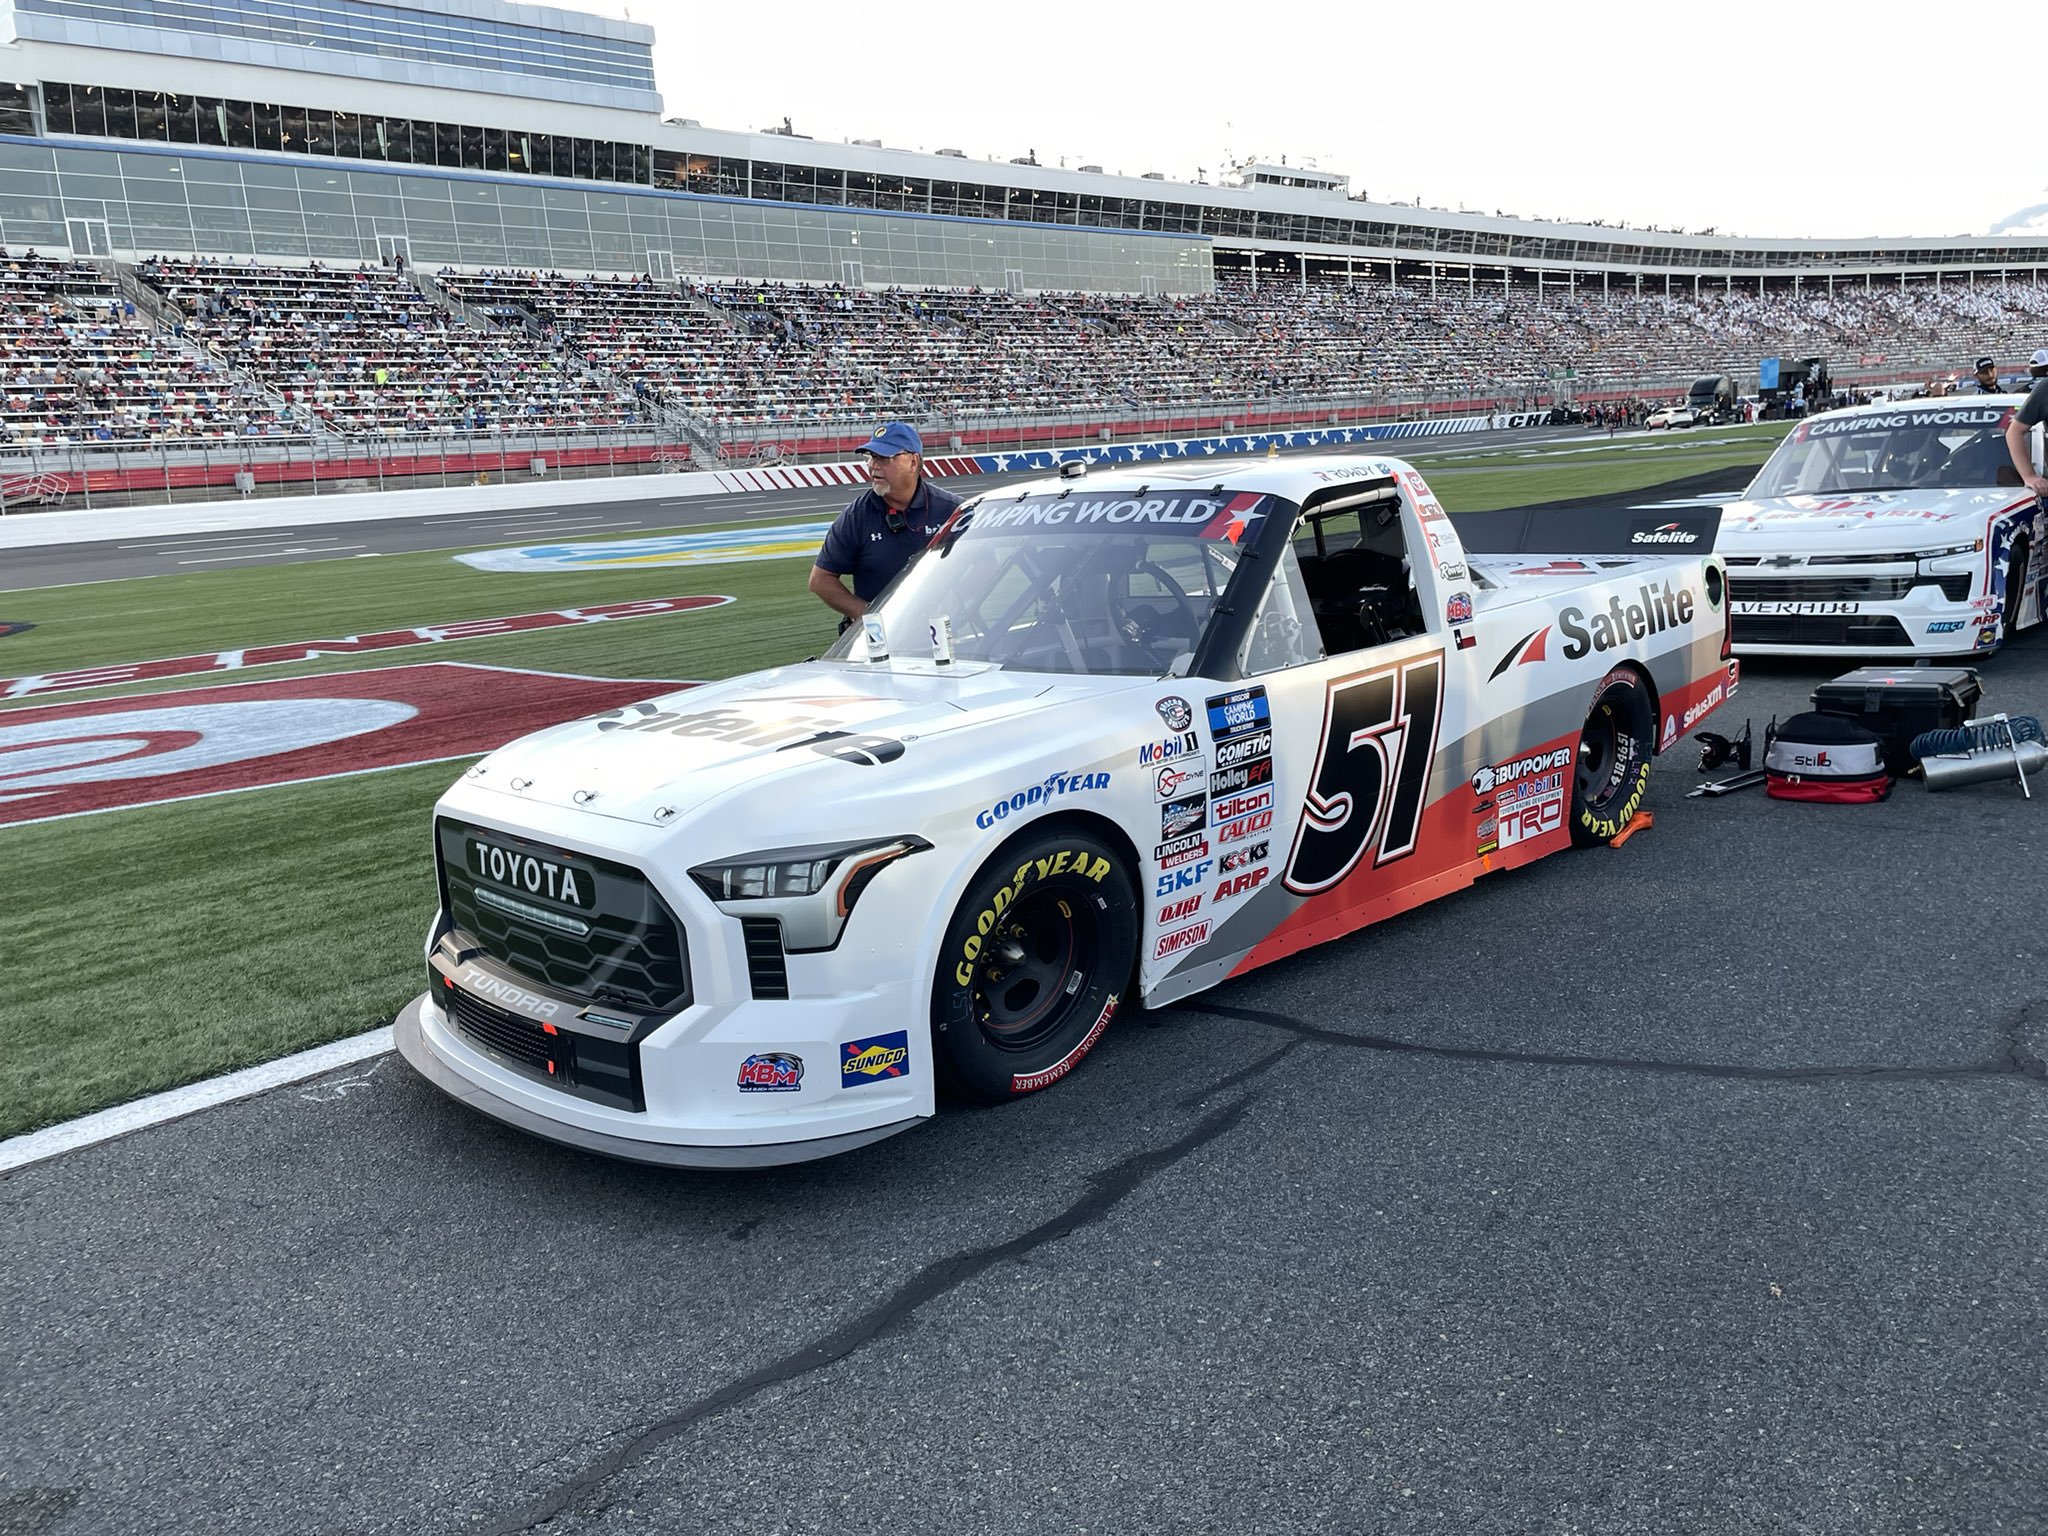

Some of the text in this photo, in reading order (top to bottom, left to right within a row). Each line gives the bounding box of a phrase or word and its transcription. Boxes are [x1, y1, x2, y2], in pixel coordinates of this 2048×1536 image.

[1508, 412, 1551, 428] CHA
[1809, 410, 2001, 437] CAMPING WORLD
[951, 502, 1075, 533] CAMPING
[1075, 499, 1215, 524] WORLD
[1631, 531, 1696, 544] Safelite
[1558, 577, 1694, 661] Safelite
[1729, 602, 1860, 614] LVERADO
[1971, 614, 2000, 627] ARP
[1223, 700, 1255, 717] CAMPING
[1231, 691, 1250, 703] NASCAR
[1225, 709, 1256, 726] WORLD
[597, 703, 906, 766] Safelite
[1139, 733, 1196, 765] Mobil 1
[1217, 733, 1271, 763] COMETIC
[1280, 647, 1446, 898] 51
[1495, 748, 1571, 786] iBUYPOWER
[1794, 751, 1832, 767] Stilo
[1211, 767, 1248, 793] Holley
[1518, 775, 1561, 800] Mobil 1
[975, 770, 1111, 830] GOODYEAR
[1215, 792, 1270, 820] tilton
[1580, 762, 1650, 837] GOODYEAR
[1218, 809, 1273, 844] CALICO
[1500, 798, 1562, 839] TRD
[1156, 834, 1201, 859] LINCOLN
[1165, 847, 1204, 868] WELDERS
[475, 842, 581, 907] TOYOTA
[1156, 859, 1213, 897] SKF
[1212, 866, 1269, 903] ARP
[955, 850, 1111, 987] GOODYEAR
[1157, 922, 1209, 957] SIMPSON
[462, 968, 560, 1017] TUNDRA
[1079, 1011, 1111, 1053] HONOR
[739, 1061, 798, 1086] KBM
[846, 1051, 904, 1072] SUNOCO
[1015, 1060, 1071, 1090] REMEMBER
